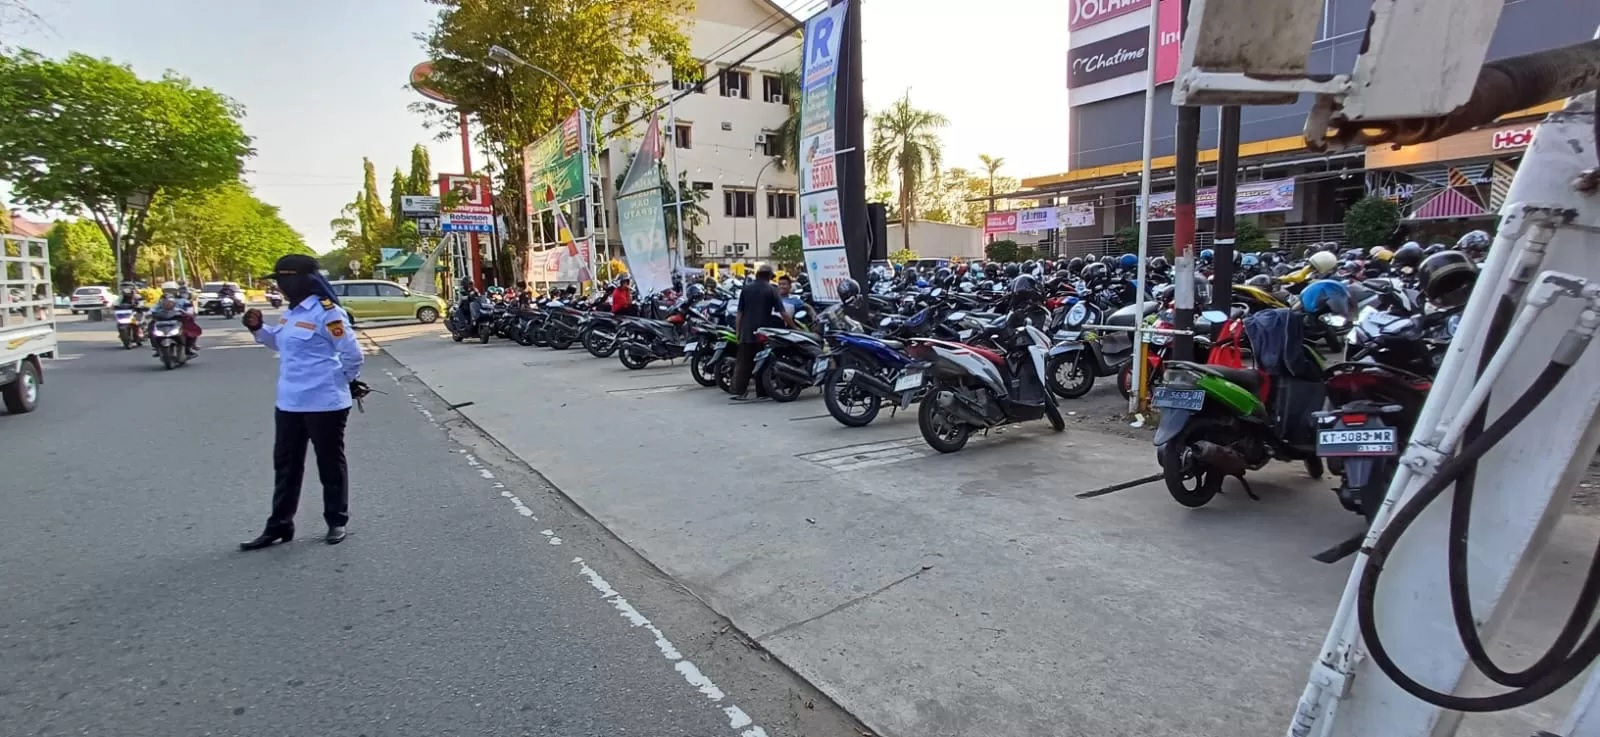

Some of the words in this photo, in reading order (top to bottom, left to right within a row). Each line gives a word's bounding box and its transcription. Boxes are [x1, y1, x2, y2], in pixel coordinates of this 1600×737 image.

[810, 16, 834, 65] R
[1160, 30, 1181, 47] In
[1084, 47, 1146, 73] Chatime
[449, 213, 489, 221] Robinson
